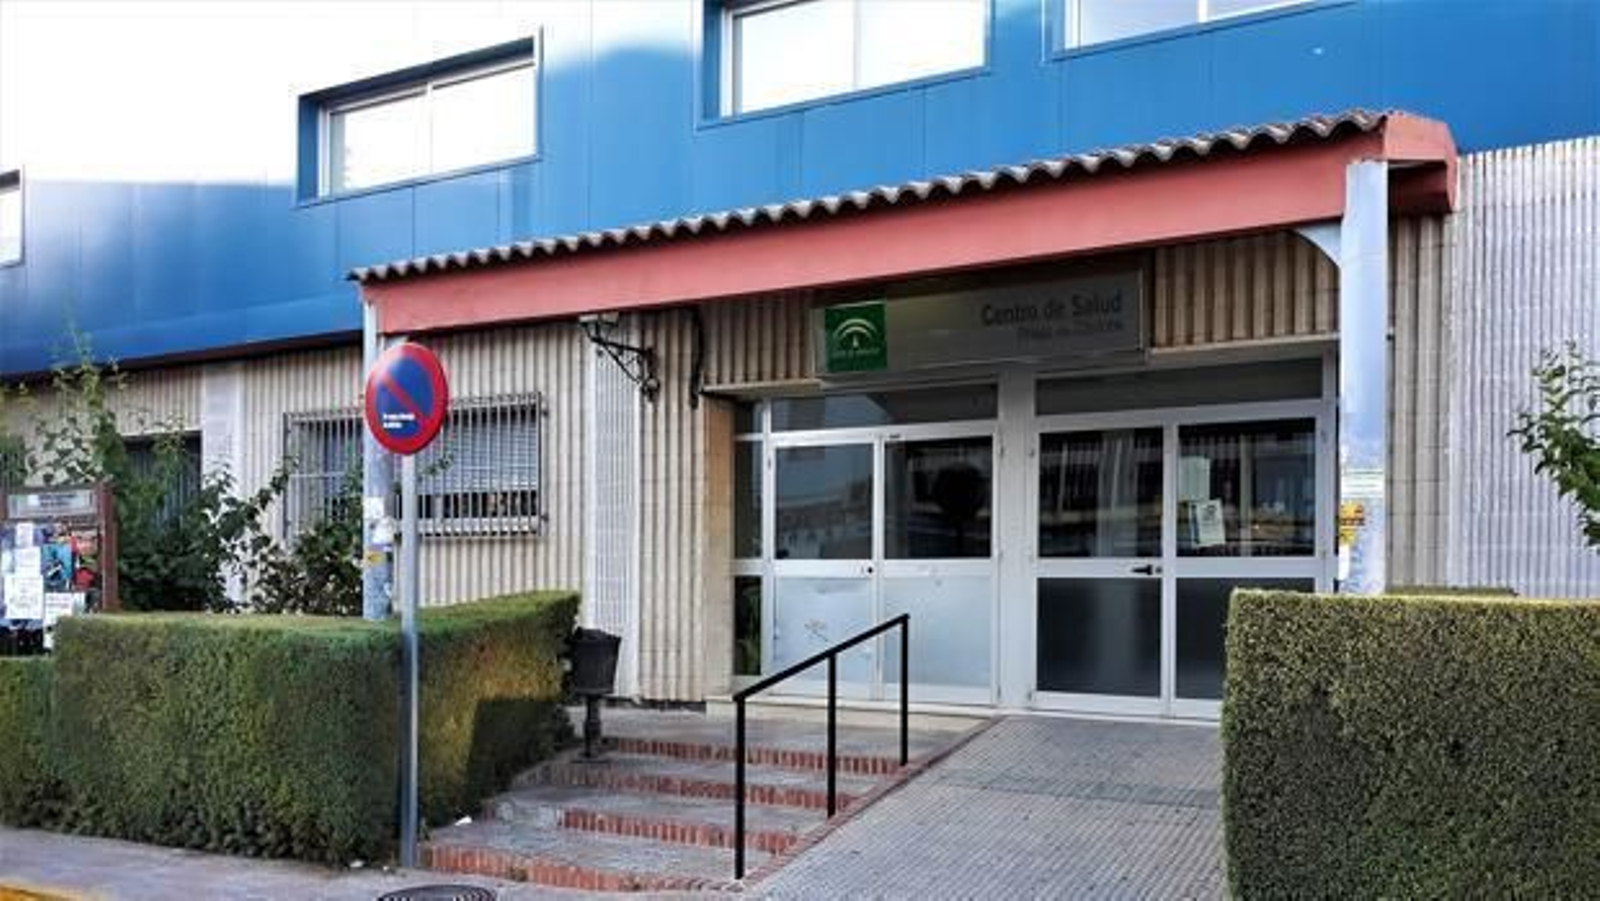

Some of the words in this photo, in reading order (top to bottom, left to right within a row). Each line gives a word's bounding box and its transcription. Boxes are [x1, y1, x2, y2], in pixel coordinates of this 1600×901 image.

[981, 303, 1038, 326] Centro
[1044, 298, 1066, 320] de
[1072, 290, 1122, 317] Salud
